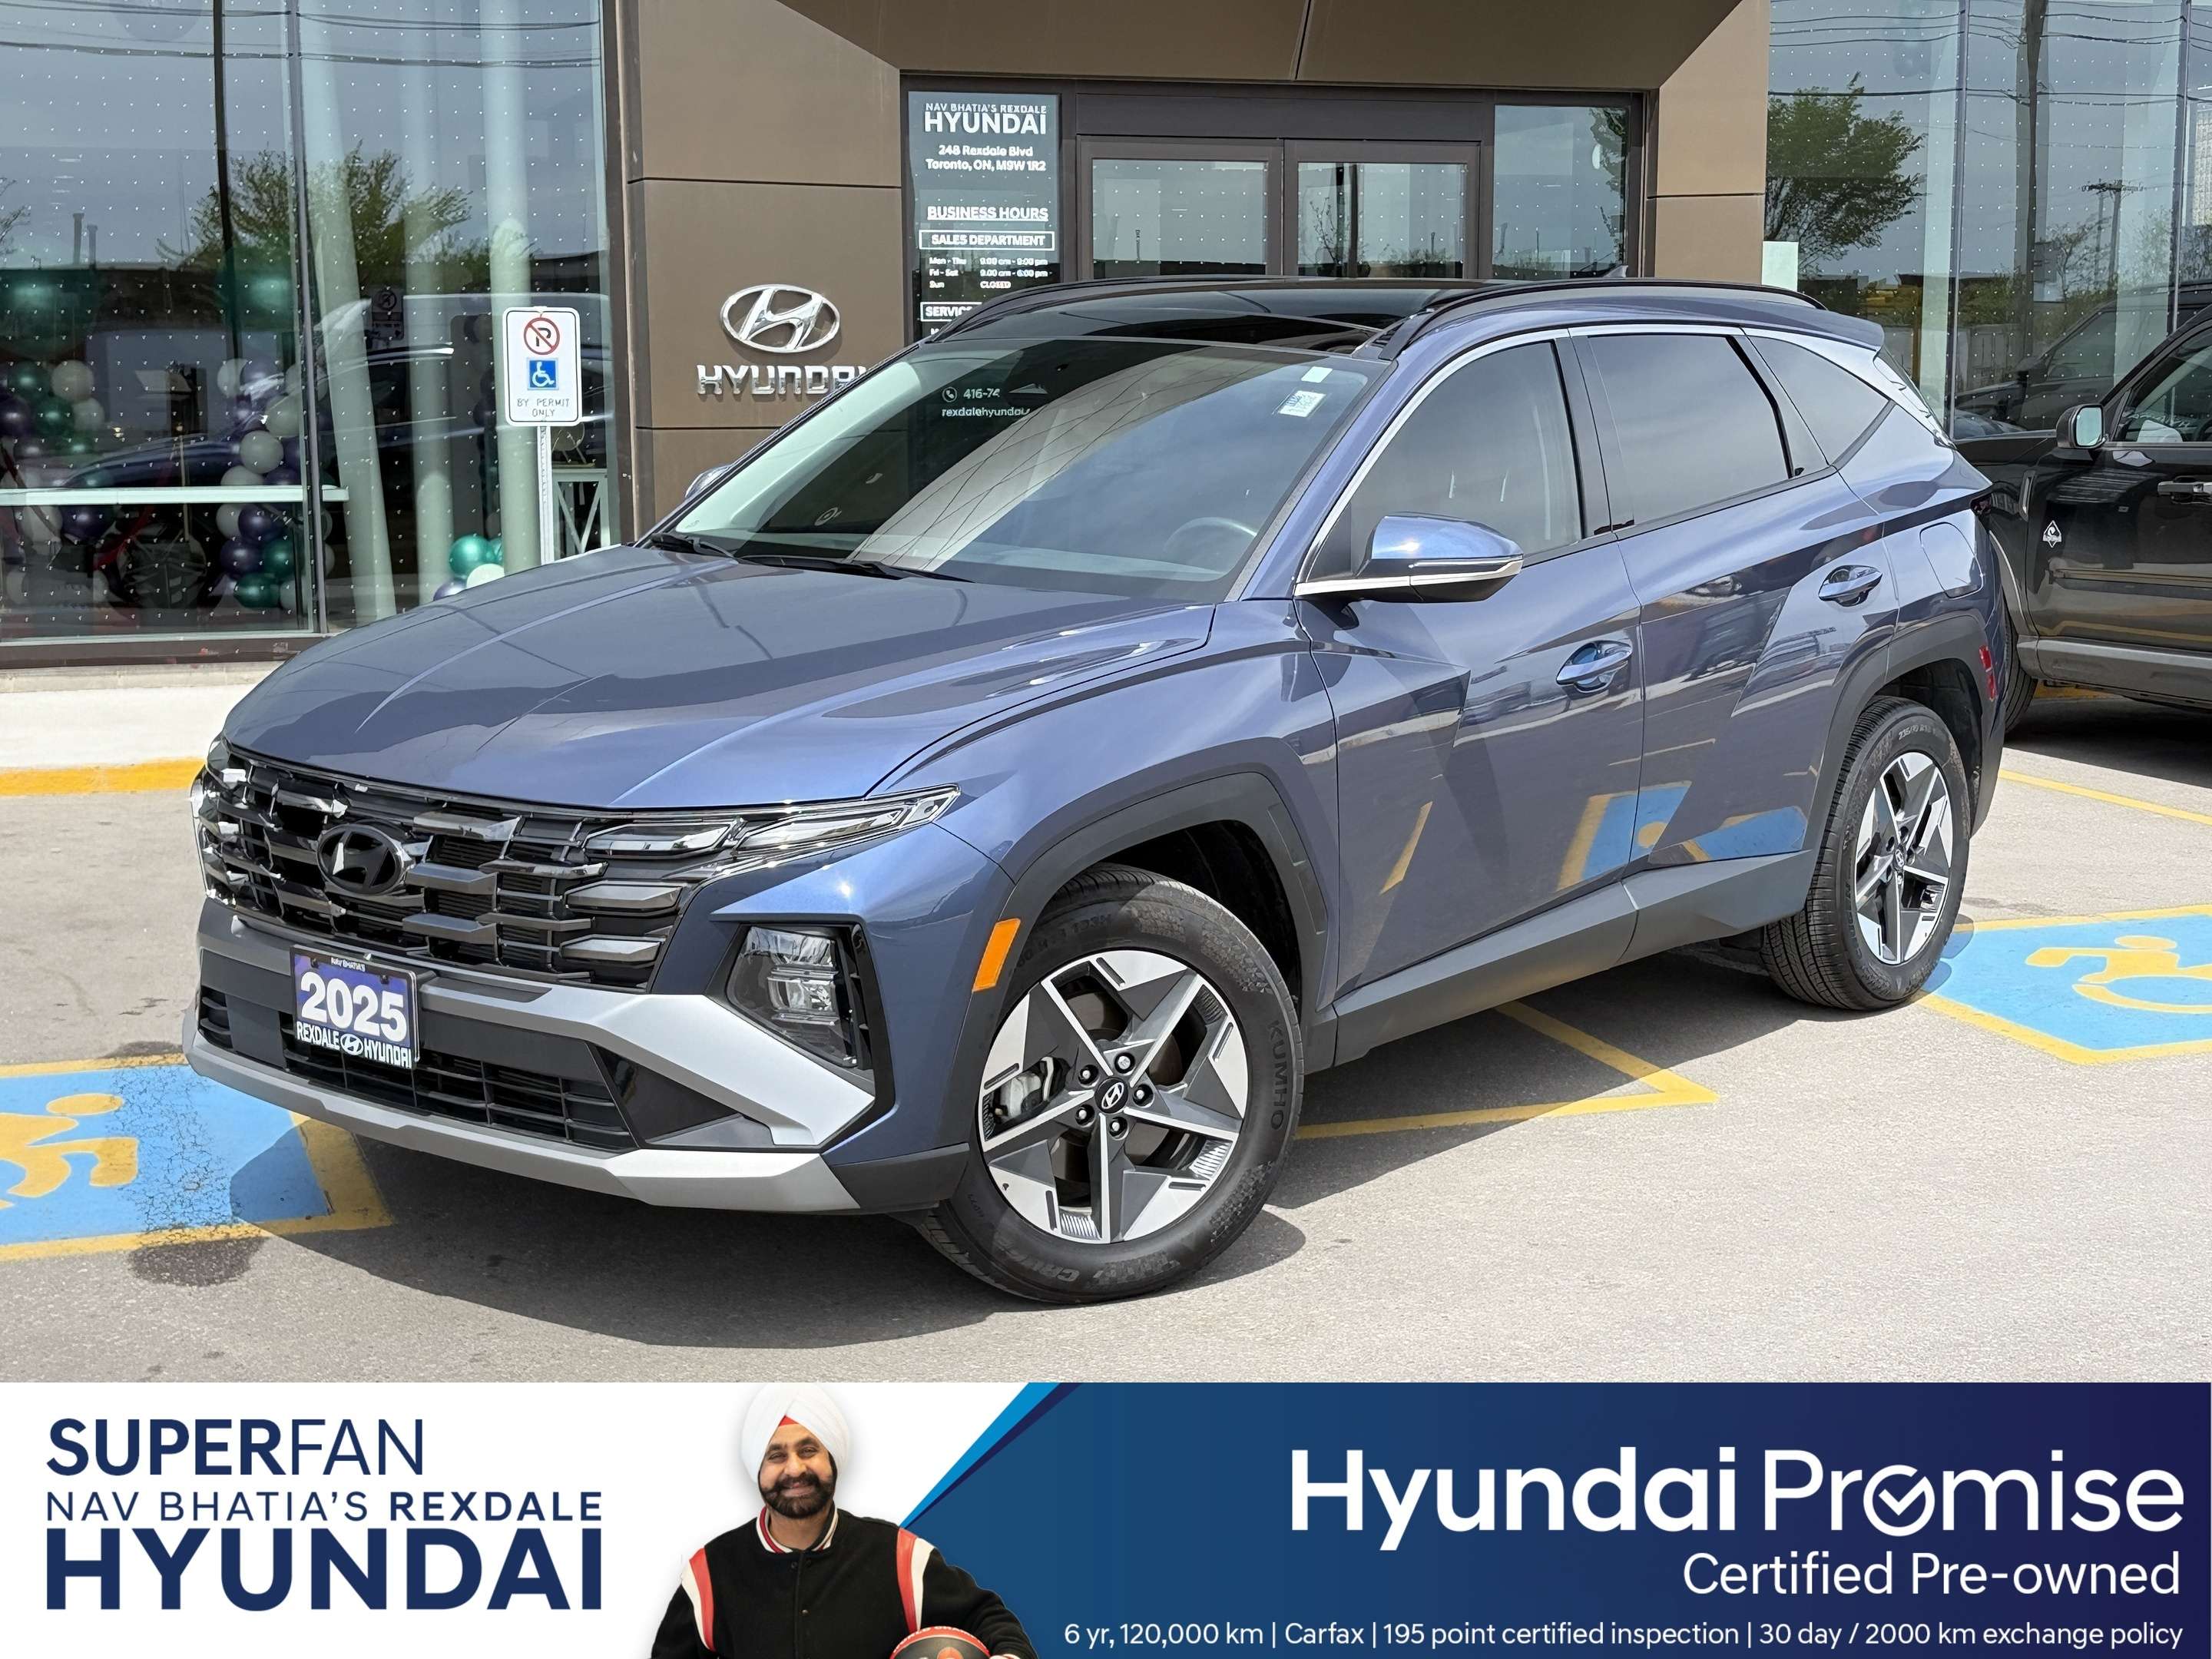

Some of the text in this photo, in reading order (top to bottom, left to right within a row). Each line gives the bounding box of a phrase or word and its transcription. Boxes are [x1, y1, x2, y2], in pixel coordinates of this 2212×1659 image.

[926, 103, 1047, 114] NAV BHATIA'S REXDALE
[924, 111, 1047, 134] HYUNDAI
[938, 144, 1034, 157] 248 Rexdale Blvd
[925, 158, 972, 172] Toronto,
[973, 159, 995, 172] ON,
[1026, 160, 1047, 171] 1R2
[927, 206, 1049, 220] BUSINESS HOURS
[931, 234, 1046, 247] SALES DEPARTMENT
[925, 306, 973, 317] SERVI
[696, 365, 867, 395] HYUNDA
[516, 398, 570, 408] BY PERMIT
[531, 408, 556, 418] ONLY
[300, 972, 407, 1042] 2025
[296, 1022, 412, 1069] REXDALE HYUNDAI
[1267, 1019, 1288, 1131] KUMHO
